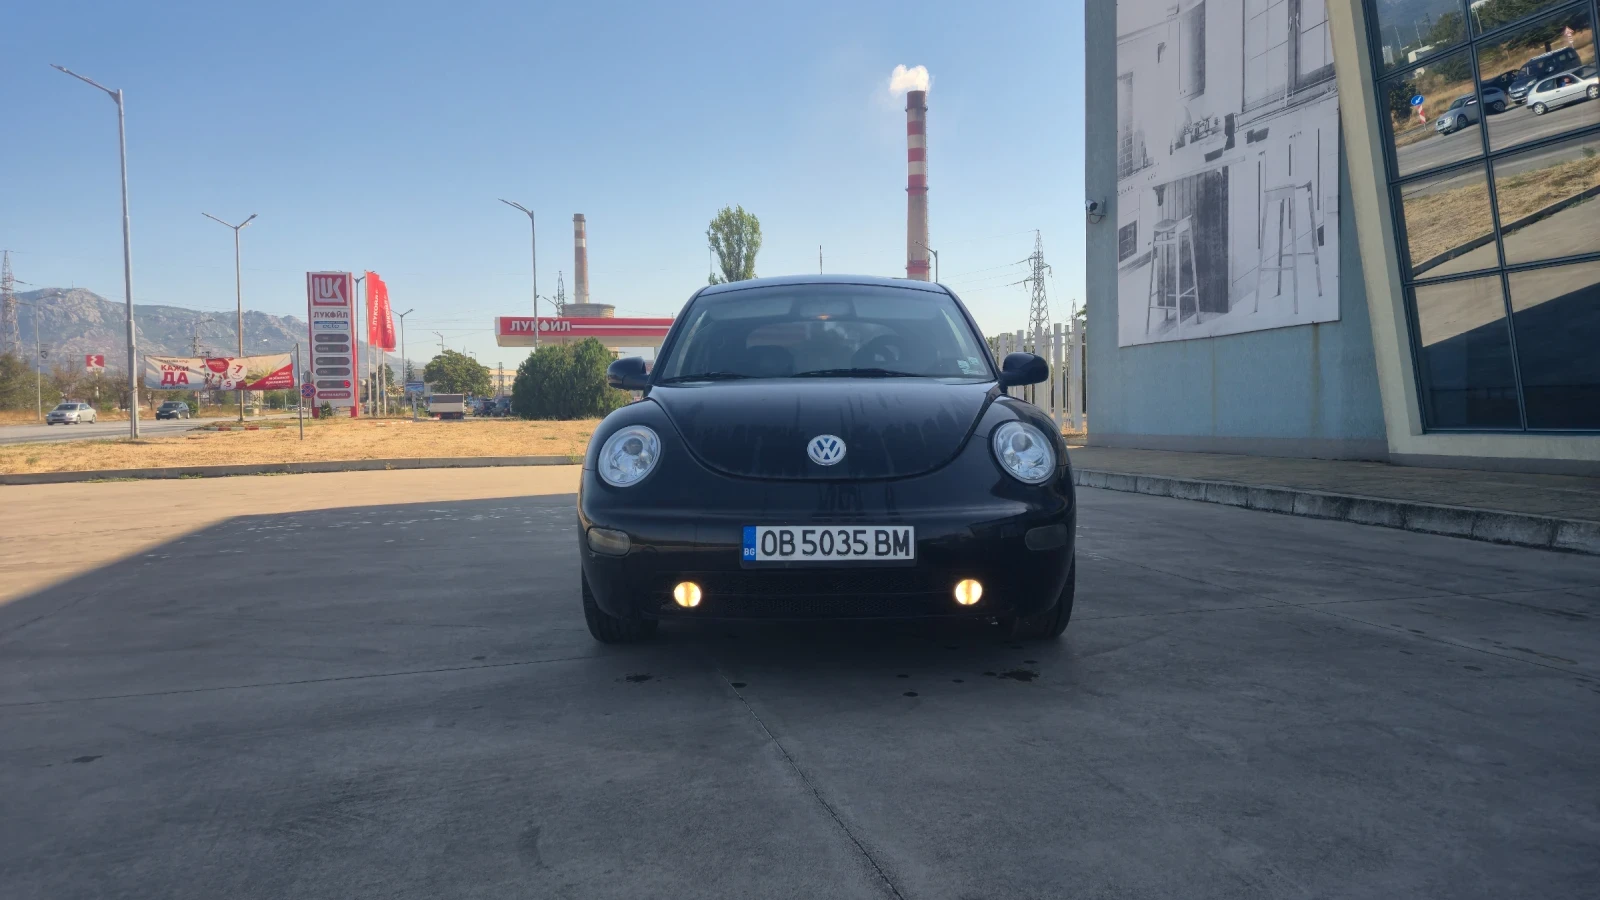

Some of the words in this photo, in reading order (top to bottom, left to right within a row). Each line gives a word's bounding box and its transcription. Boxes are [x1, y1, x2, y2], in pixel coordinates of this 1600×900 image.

[313, 310, 349, 318] ЛУКОЙЛ
[510, 318, 571, 332] ЛУКОЙЛ
[160, 364, 189, 372] КАЖИ
[161, 371, 189, 386] ДА
[761, 530, 796, 557] OB
[801, 530, 868, 557] 5035
[874, 530, 910, 557] BM
[744, 548, 756, 556] BG
